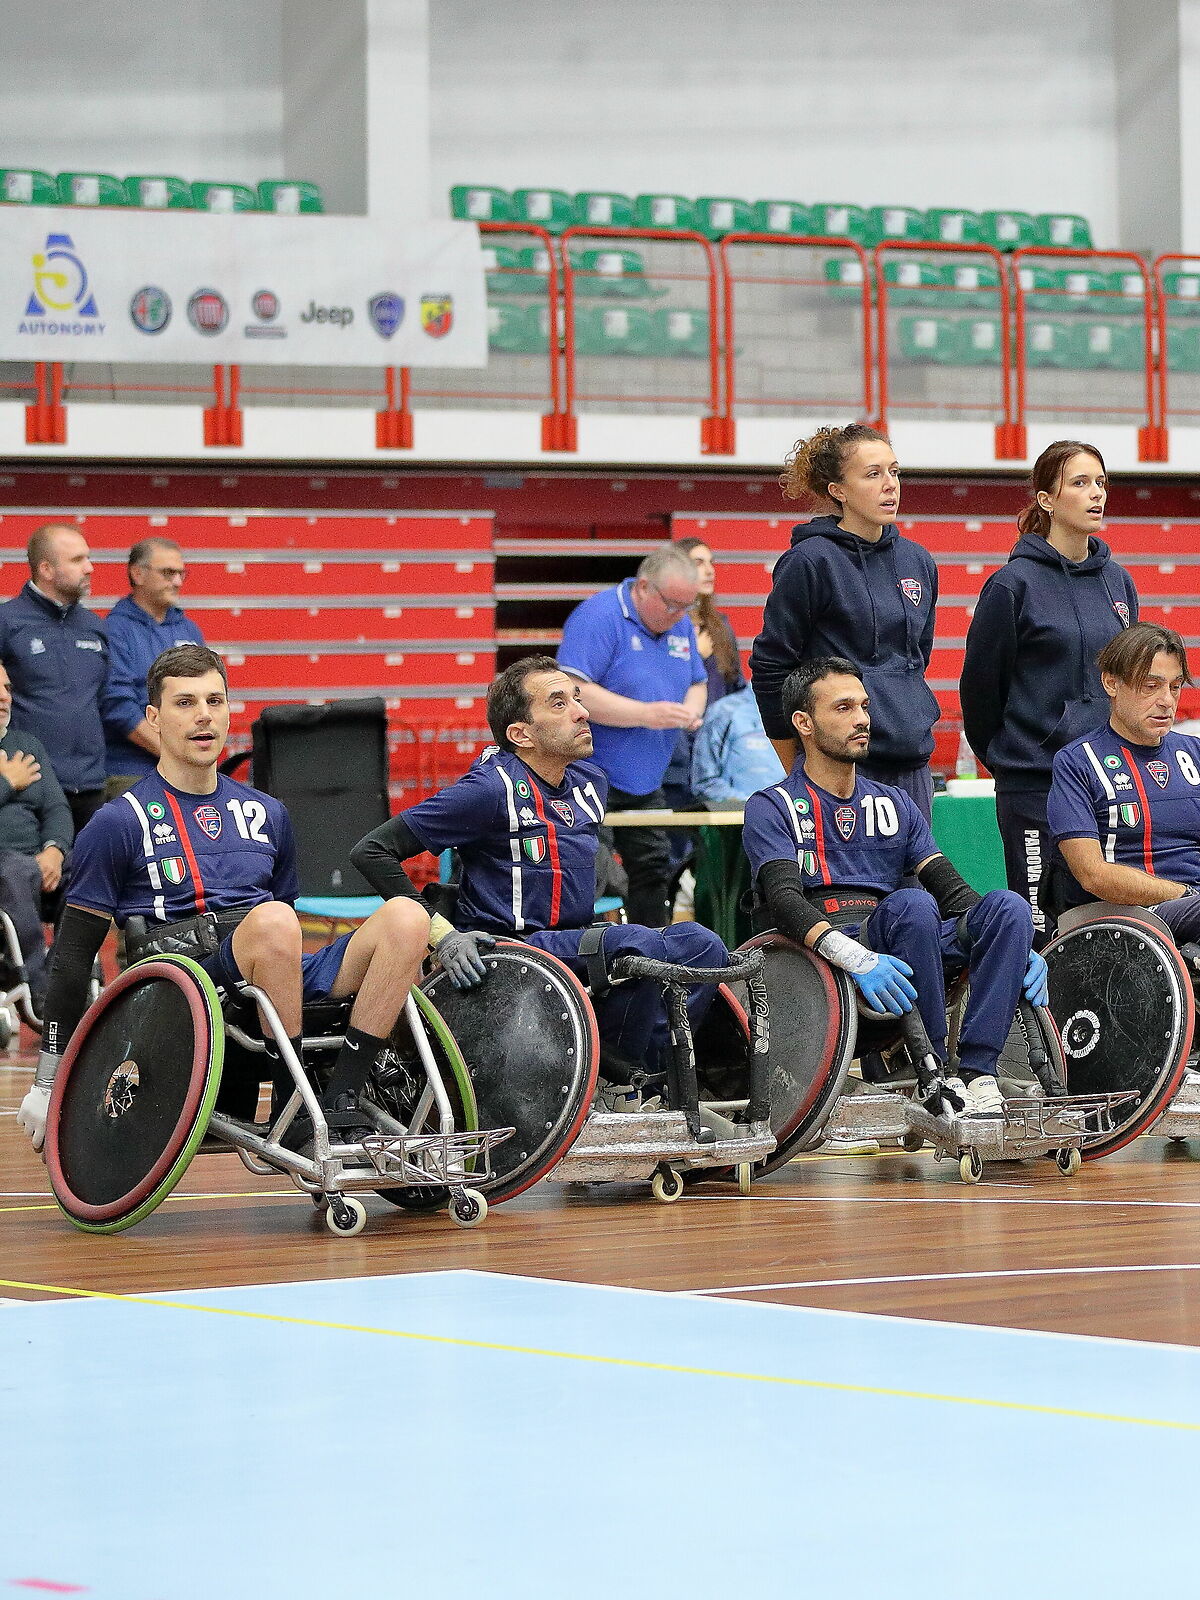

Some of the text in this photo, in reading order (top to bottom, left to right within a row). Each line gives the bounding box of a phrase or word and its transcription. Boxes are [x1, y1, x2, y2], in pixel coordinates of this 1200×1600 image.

[18, 322, 106, 336] AUTONOMY
[302, 300, 354, 328] Jeep
[1175, 750, 1200, 786] 8
[225, 798, 270, 844] 12
[860, 794, 900, 837] 10
[1024, 829, 1042, 882] PADOVA
[839, 899, 878, 907] DOMYOS
